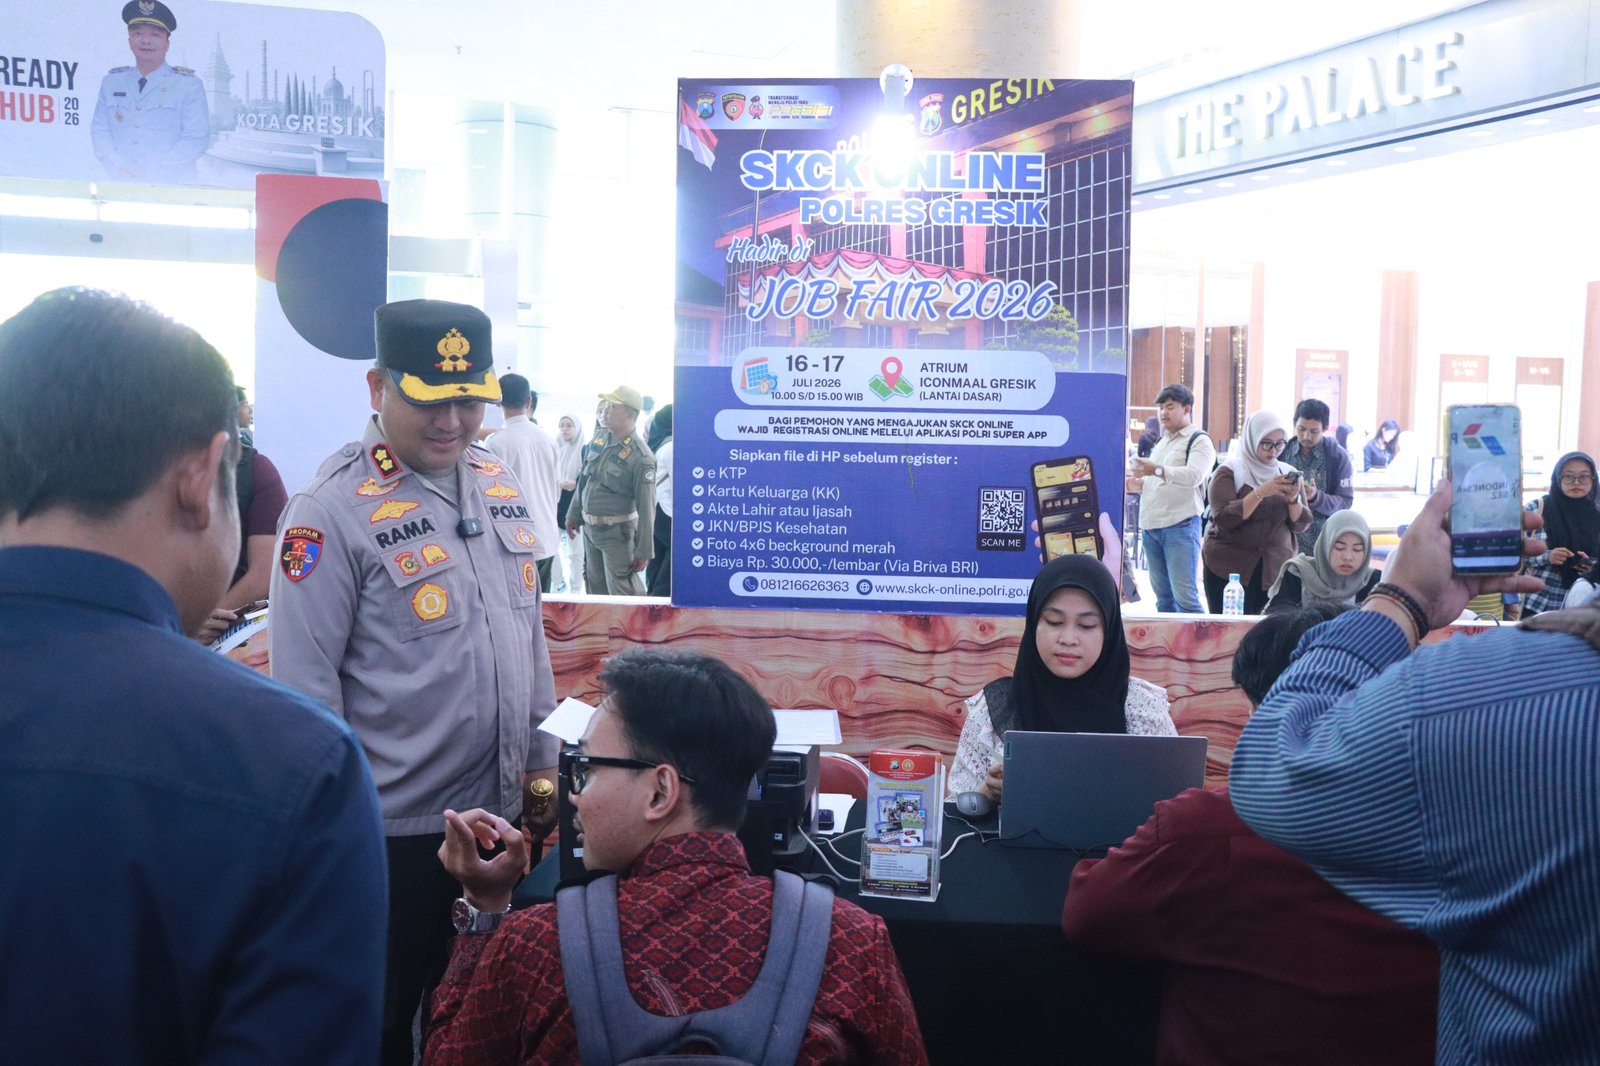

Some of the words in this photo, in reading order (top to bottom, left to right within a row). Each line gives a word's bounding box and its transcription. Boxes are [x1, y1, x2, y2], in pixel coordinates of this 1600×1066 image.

[0, 55, 78, 91] READY
[64, 96, 79, 110] 20
[951, 78, 1055, 124] GRESIK
[1165, 94, 1244, 159] THE
[1254, 31, 1464, 139] PALACE
[0, 91, 55, 124] HUB
[64, 112, 80, 126] 26
[237, 112, 280, 129] KOTA
[285, 114, 376, 138] GRESIK
[740, 149, 863, 190] SKCK
[800, 198, 927, 225] POLRES
[930, 199, 1049, 226] GRESIK
[726, 234, 787, 263] Hadir
[788, 236, 815, 262] di
[746, 275, 838, 322] JOB
[844, 276, 942, 322] FAIR
[946, 279, 1059, 322] 2026
[920, 362, 968, 373] ATRIUM
[792, 378, 812, 388] JULI
[814, 378, 841, 388] 2026
[920, 377, 987, 388] ICONMAAL
[990, 378, 1036, 389] GRESIK
[771, 392, 796, 400] 10.00
[798, 392, 815, 401] S/D
[817, 392, 842, 400] 15.00
[844, 393, 864, 401] WIB
[919, 391, 960, 401] (LANTAI
[962, 392, 1002, 402] DASAR)
[768, 416, 792, 425] BAGI
[794, 417, 844, 426] PEMOHON
[846, 418, 875, 426] YANG
[877, 418, 948, 428] MENGAJUKAN
[950, 420, 975, 428] SKCK
[977, 420, 1014, 429] ONLINE
[737, 426, 769, 434] WAJIB
[773, 426, 830, 435] REGISTRASI
[832, 428, 868, 436] ONLINE
[870, 428, 914, 437] MELELUI
[916, 429, 960, 438] APLIKASI
[962, 430, 991, 438] POLRI
[993, 430, 1025, 439] SUPER
[1026, 431, 1048, 439] APP
[730, 449, 781, 464] Siapkan
[784, 450, 804, 461] file
[806, 450, 819, 462] di
[822, 451, 841, 462] HP
[843, 451, 898, 464] sebelum
[901, 452, 952, 466] register
[708, 469, 716, 479] e
[719, 467, 747, 479] KTP
[708, 484, 745, 498] Kartu
[748, 486, 808, 500] Keluarga
[812, 486, 840, 501] (KK)
[490, 504, 529, 520] POLRI
[708, 503, 739, 515] Akte
[742, 504, 776, 516] Lahir
[779, 506, 810, 517] atau
[812, 504, 852, 519] Ijasah
[288, 528, 318, 538] PROPAM
[376, 517, 436, 549] RAMA
[708, 520, 772, 534] JKN/BPJS
[776, 522, 848, 535] Kesehatan
[708, 538, 736, 550] Foto
[739, 538, 766, 550] 4x6
[768, 540, 849, 554] beckground
[852, 542, 896, 554] merah
[981, 538, 1005, 547] SCAN
[708, 555, 744, 570] Biaya
[747, 556, 768, 570] Rp.
[771, 556, 881, 572] 30.000,-/lembar
[884, 560, 910, 574] (Via
[913, 560, 948, 574] Briva
[951, 561, 979, 576] BRI)
[760, 578, 850, 592] 081216626363
[875, 583, 1029, 598] www.skck-online.polri.go.i
